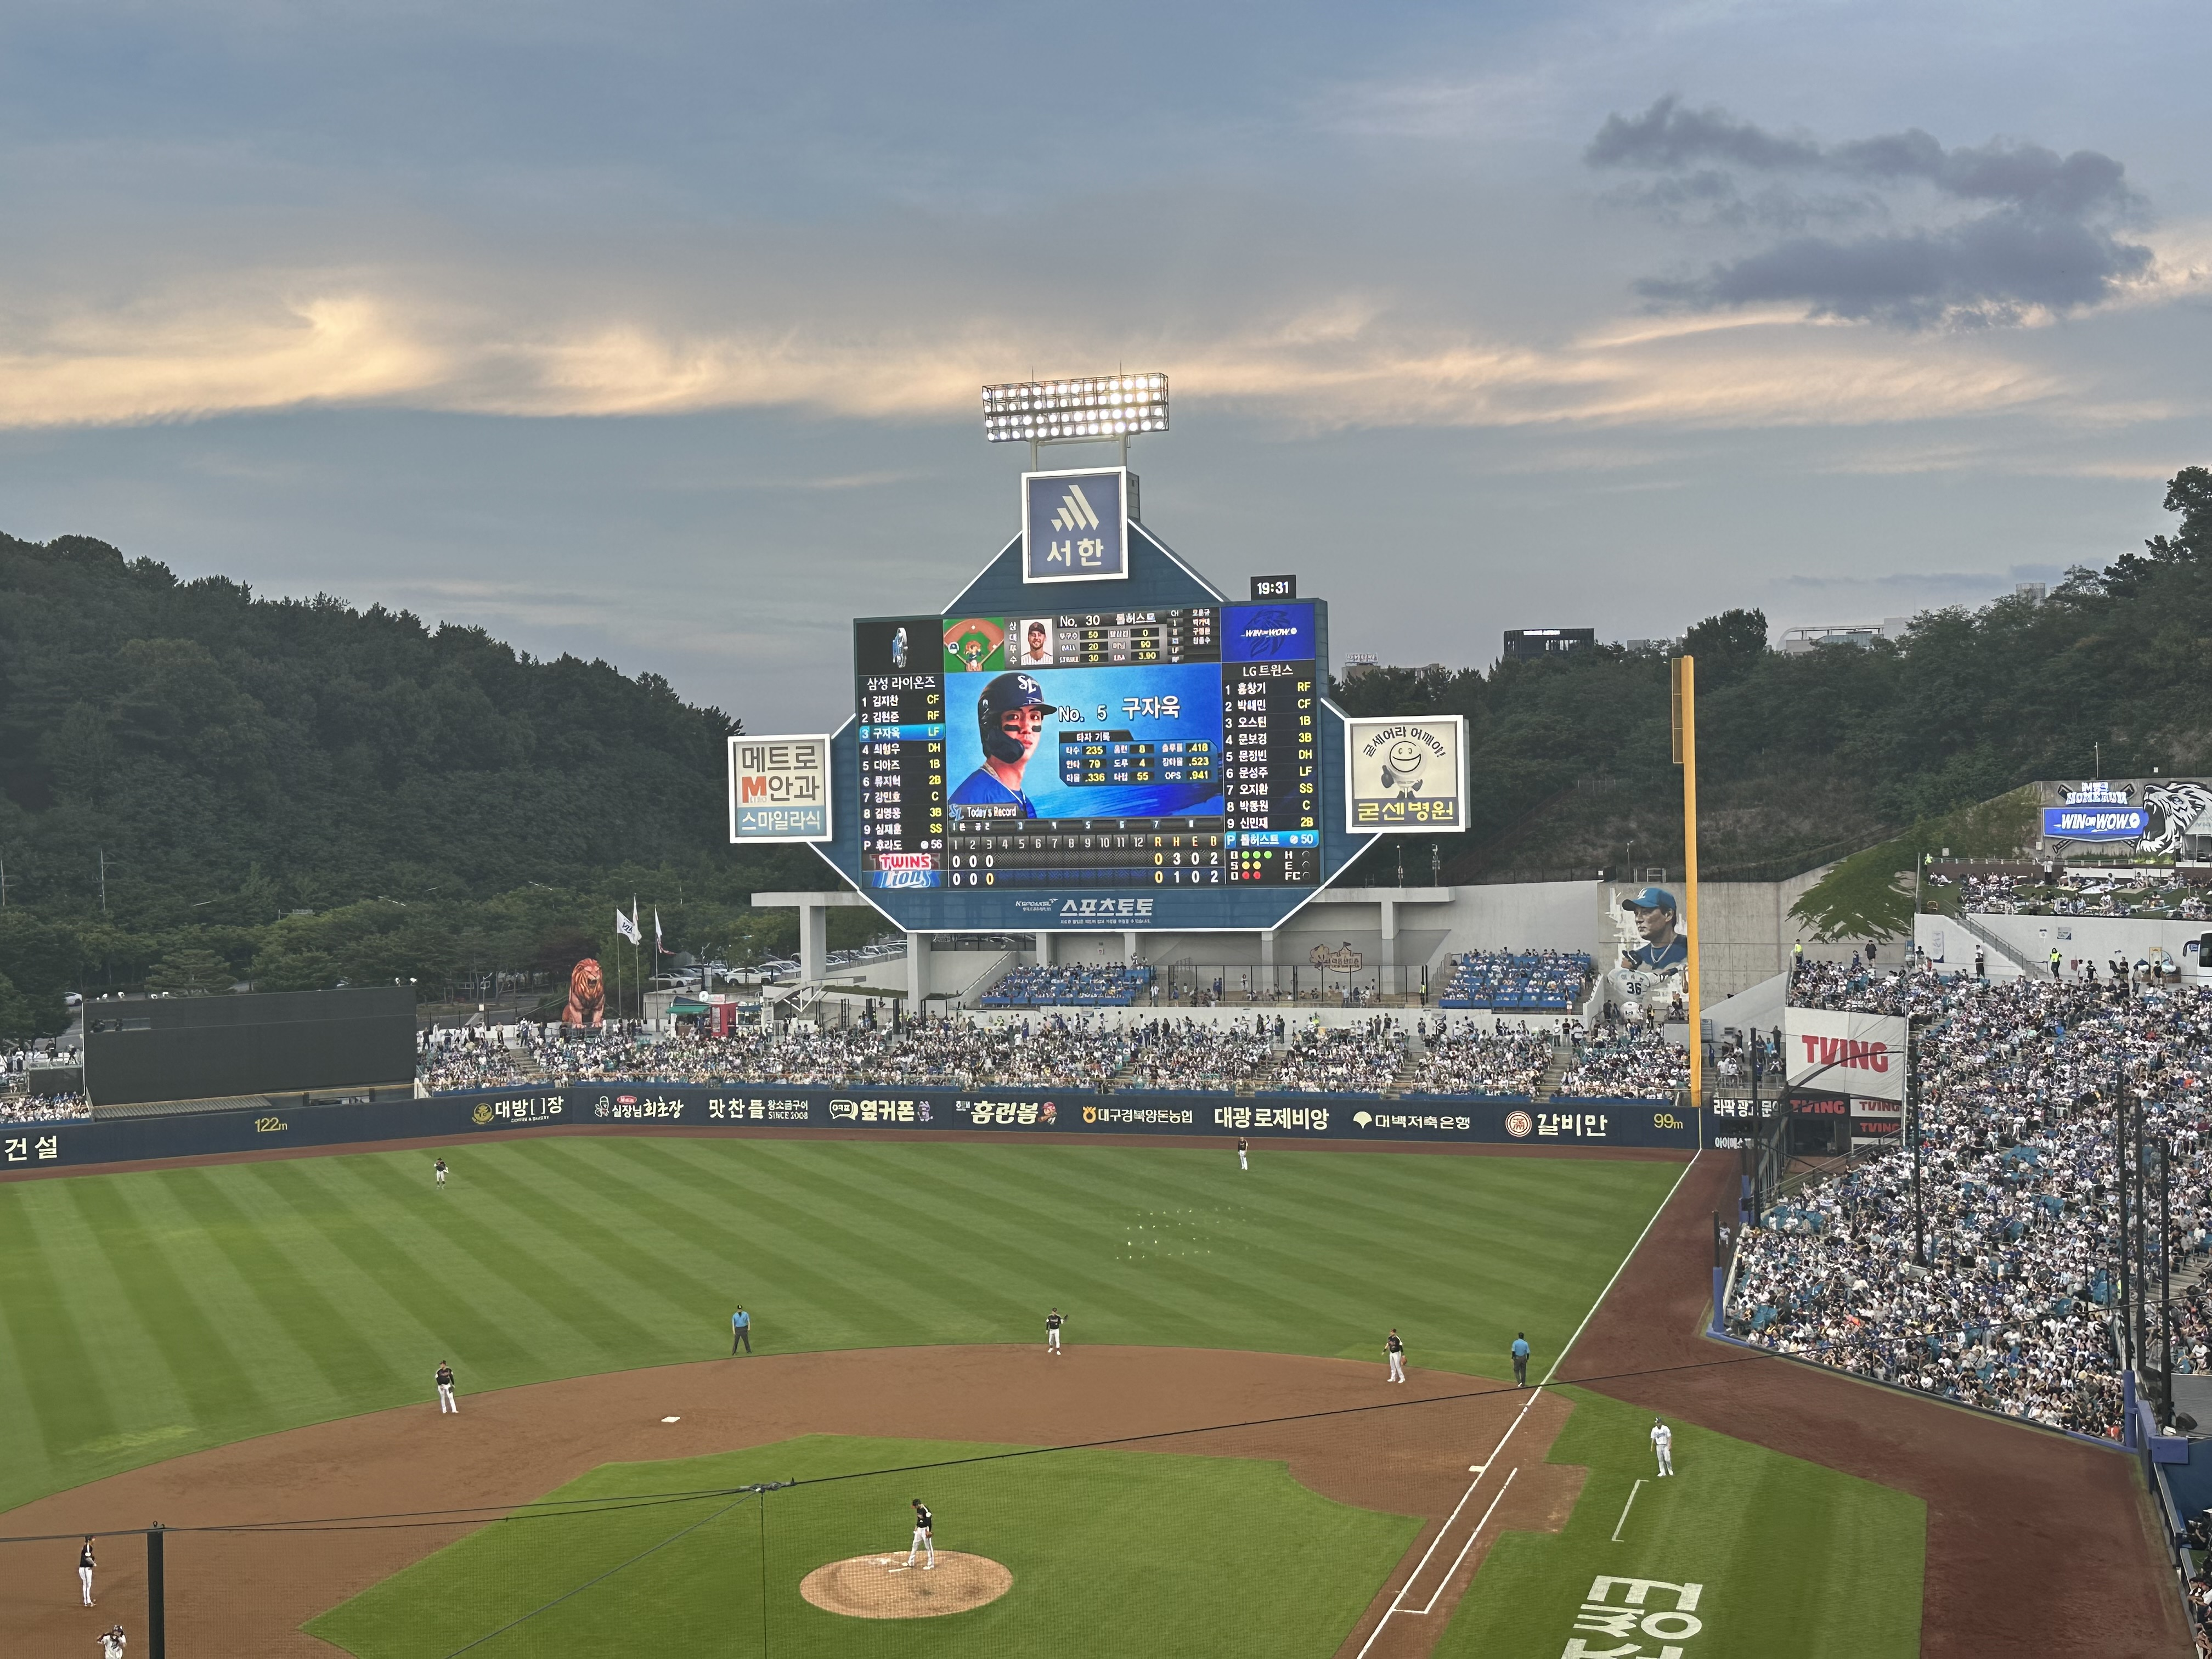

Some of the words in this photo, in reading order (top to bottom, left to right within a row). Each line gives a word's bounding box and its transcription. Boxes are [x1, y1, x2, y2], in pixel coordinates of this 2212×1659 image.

[1047, 538, 1104, 566] 서한
[1257, 582, 1289, 595] 19:31
[1060, 616, 1077, 627] No.
[1086, 615, 1100, 625] 30
[1243, 667, 1256, 676] LG
[1259, 664, 1293, 676] 트윈스
[867, 678, 888, 691] 삼성
[892, 676, 935, 690] 라이온즈
[1226, 685, 1229, 695] 1
[1297, 682, 1311, 691] RF
[862, 697, 866, 707] 1
[873, 695, 899, 707] 김지찬
[927, 695, 939, 704] CF
[1225, 702, 1232, 712] 2
[1298, 699, 1311, 708] CF
[1059, 706, 1085, 722] No.
[1097, 704, 1107, 720] 5
[1122, 696, 1180, 720] 구자욱
[862, 713, 868, 723] 2
[928, 711, 940, 720] RF
[1226, 718, 1232, 728] 3
[1238, 716, 1266, 727] 오스틴
[1300, 716, 1311, 725] 1B
[862, 729, 868, 738] 3
[873, 727, 900, 738] 구자욱
[928, 727, 939, 736] LF
[1076, 733, 1092, 742] 타자
[1226, 735, 1233, 744] 4
[1239, 733, 1267, 745] 문보경
[1299, 732, 1312, 742] 3B
[1363, 726, 1407, 757] 굳세어라
[862, 745, 868, 754] 4
[928, 743, 940, 752] DH
[1086, 746, 1103, 754] 235
[1189, 743, 1208, 752] .418
[1226, 752, 1233, 761] 5
[1299, 749, 1312, 759] DH
[742, 746, 817, 772] 메트로
[862, 761, 869, 770] 5
[874, 759, 900, 771] 디아즈
[929, 759, 940, 768] 1B
[1139, 759, 1145, 767] 4
[1189, 757, 1209, 766] .523
[1085, 773, 1105, 782] .336
[1137, 772, 1148, 781] 55
[1165, 771, 1181, 780] OPS
[1189, 770, 1208, 780] .941
[1226, 769, 1233, 778] 6
[1239, 767, 1268, 778] 문성주
[1299, 766, 1312, 776] LF
[863, 777, 870, 786] 6
[929, 775, 941, 785] 2B
[769, 776, 820, 802] 안과
[1227, 785, 1233, 795] 7
[1239, 783, 1268, 795] 오지환
[1300, 783, 1313, 793] SS
[864, 793, 870, 803] 7
[932, 792, 939, 800] C
[967, 806, 992, 819] Today's
[994, 806, 1016, 817] Record
[1227, 802, 1234, 812] 8
[1302, 800, 1310, 810] C
[1358, 801, 1453, 821] 굳센병원
[864, 809, 870, 819] 8
[930, 808, 941, 817] 3B
[742, 810, 820, 831] 스마일라식
[1227, 819, 1234, 828] 9
[1240, 817, 1268, 829] 신민재
[1301, 817, 1313, 827] 2B
[2062, 814, 2086, 829] WIN
[2095, 814, 2130, 830] WOW
[864, 825, 870, 834] 9
[930, 823, 942, 833] SS
[864, 840, 871, 850] P
[876, 839, 902, 851] 후라도
[931, 839, 942, 849] 56
[1155, 837, 1161, 847] R
[1173, 837, 1179, 847] H
[1193, 836, 1198, 847] E
[1227, 835, 1235, 845] P
[1301, 834, 1313, 844] 50
[881, 855, 930, 868] TWINS
[953, 855, 960, 867] 0
[969, 855, 977, 867] 0
[986, 855, 994, 866] 0
[1154, 853, 1163, 865] 0
[1173, 853, 1181, 865] 3
[1192, 852, 1199, 865] 0
[1211, 852, 1217, 864] 2
[953, 873, 960, 885] 0
[969, 873, 977, 885] 0
[986, 872, 994, 884] 0
[1155, 871, 1163, 883] 0
[1174, 871, 1179, 883] 1
[1192, 871, 1200, 883] 0
[1211, 870, 1218, 882] 2
[1285, 872, 1300, 880] FC
[1059, 899, 1153, 917] 스포츠토토
[1626, 982, 1641, 995] 36
[1802, 1035, 1888, 1073] TVING
[644, 1096, 684, 1119] 회초장
[861, 1100, 915, 1121] 옆커폰
[970, 1101, 1038, 1124] 홈런볼
[1790, 1100, 1846, 1114] TVING
[255, 1117, 287, 1132] 122m
[1375, 1114, 1470, 1130] 대백저축은행
[1537, 1114, 1607, 1137] 갈비만
[1654, 1113, 1683, 1130] 99m
[4, 1136, 57, 1161] 건설
